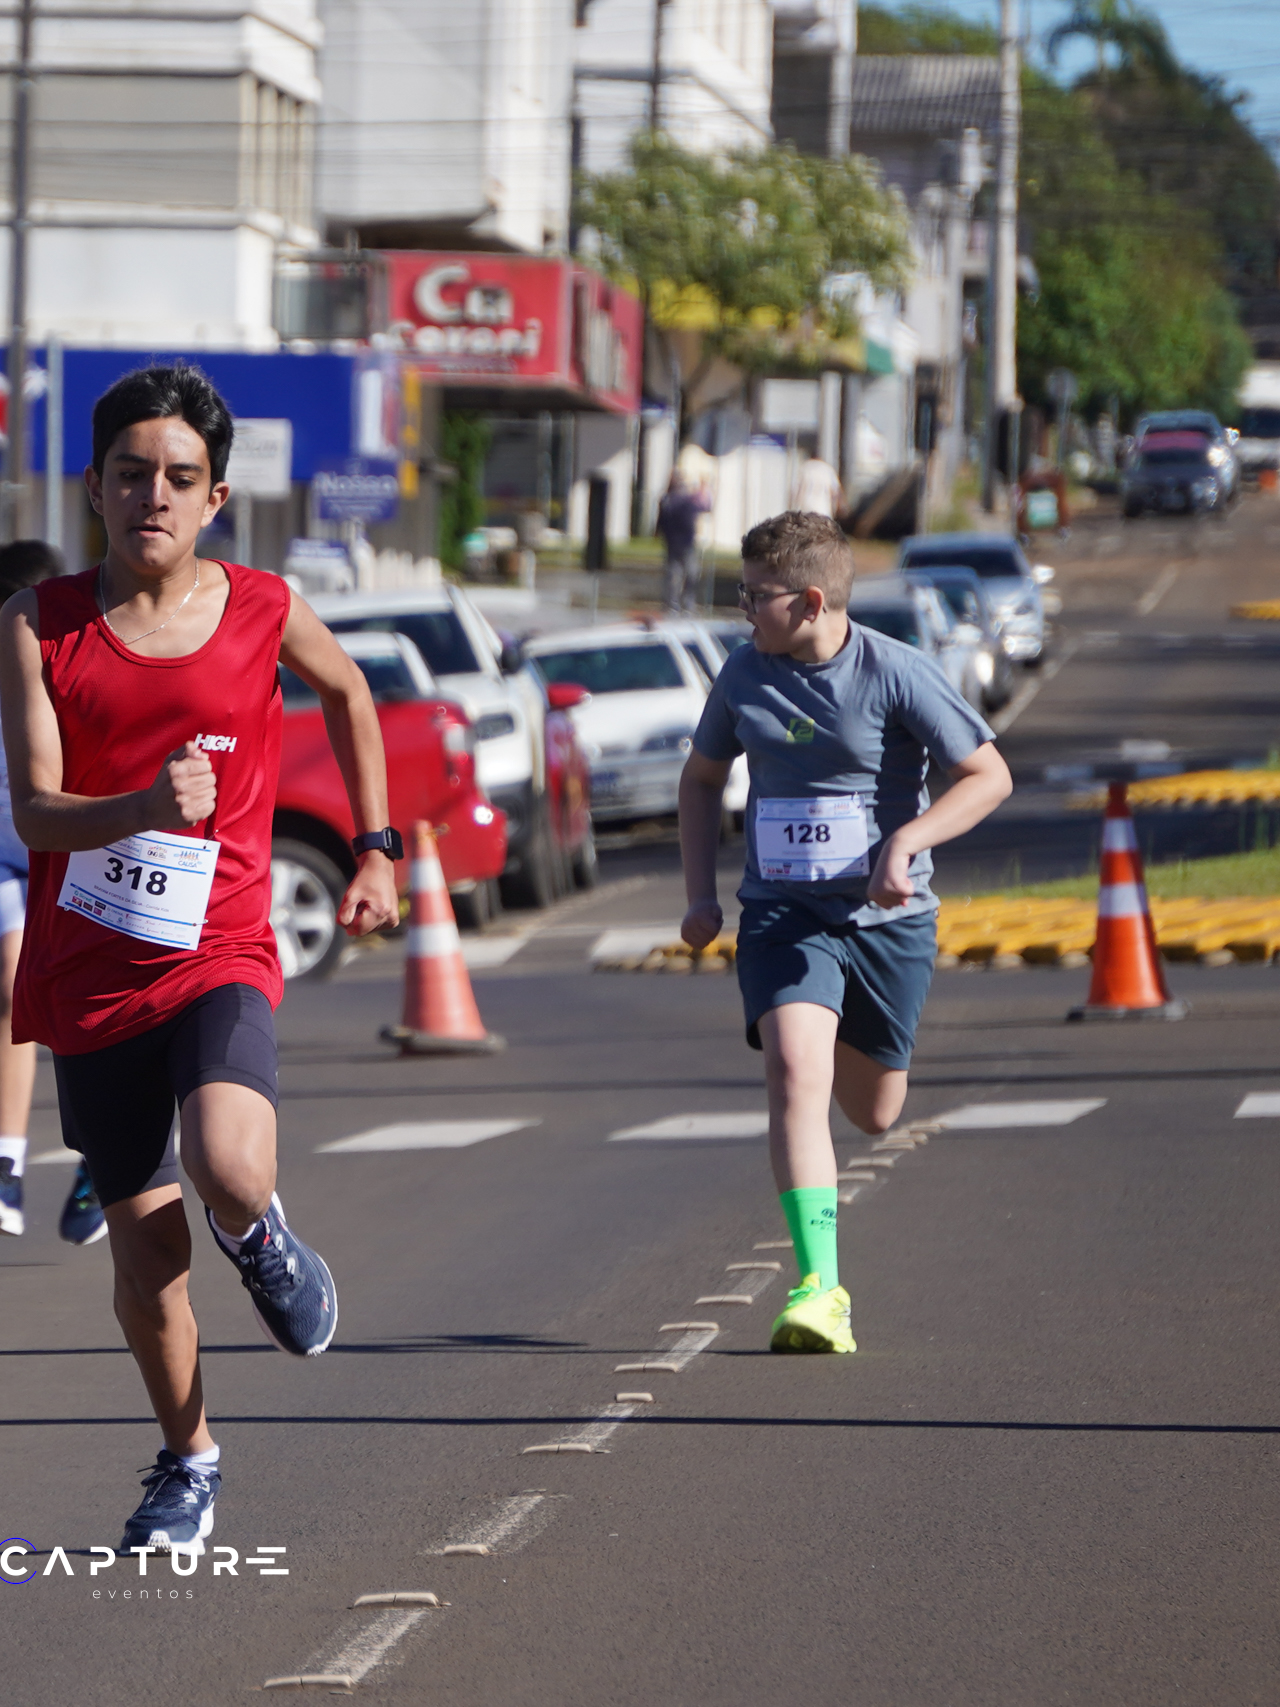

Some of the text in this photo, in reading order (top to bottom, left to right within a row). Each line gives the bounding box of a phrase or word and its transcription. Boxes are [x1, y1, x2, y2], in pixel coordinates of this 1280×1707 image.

[194, 733, 238, 753] HIGH
[783, 822, 831, 844] 128
[104, 857, 168, 896] 318
